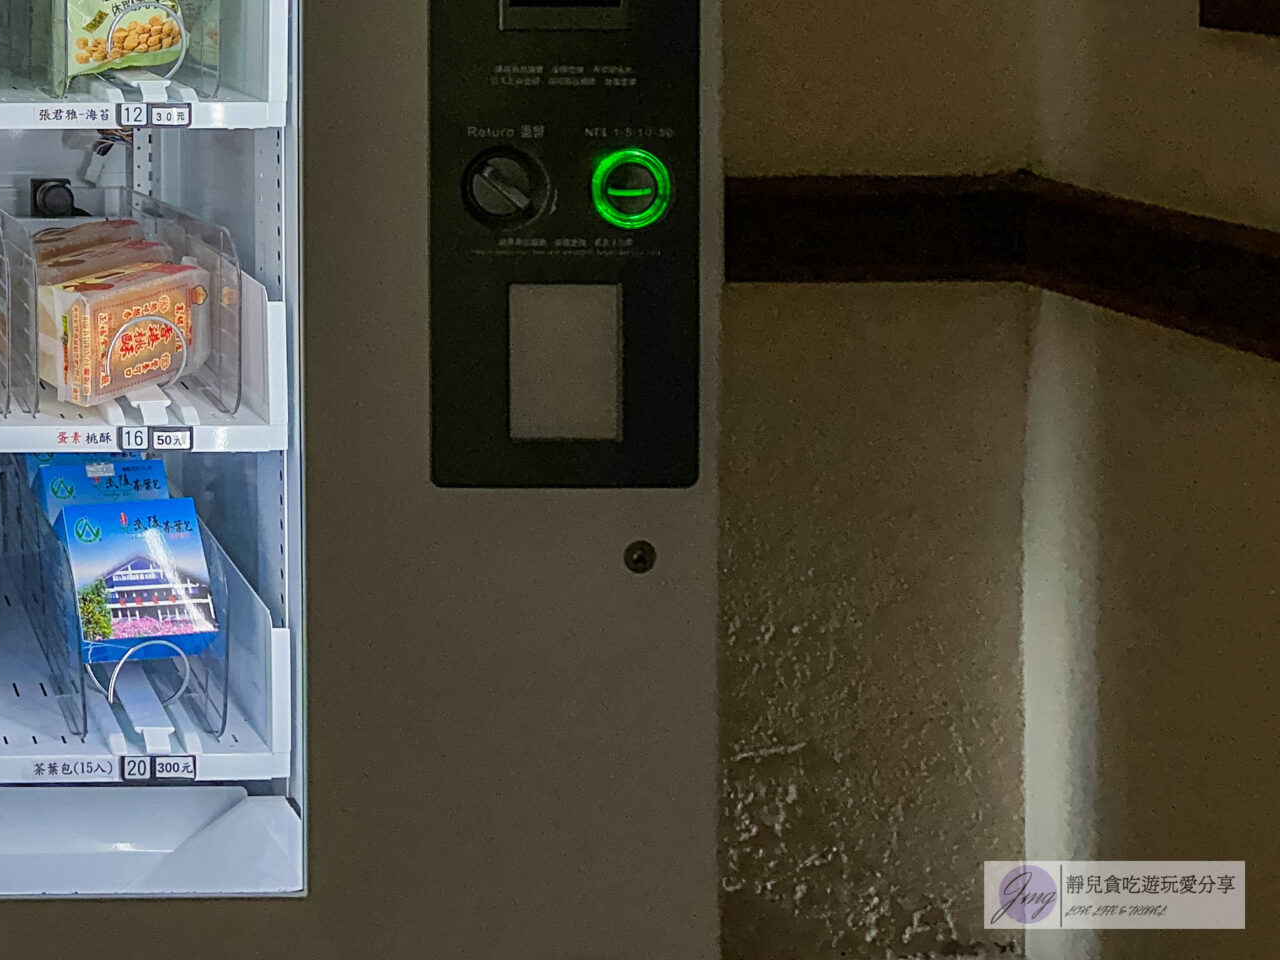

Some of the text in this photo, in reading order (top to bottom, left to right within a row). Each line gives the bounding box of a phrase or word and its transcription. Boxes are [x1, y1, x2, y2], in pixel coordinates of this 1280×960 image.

[38, 108, 110, 121] 張君雅-海苔
[123, 106, 143, 123] 12
[56, 431, 112, 446] 蛋素 桃酥
[124, 430, 143, 447] 16
[156, 435, 187, 447] 50元
[33, 761, 114, 776] 茶葉包(15入)
[127, 759, 147, 776] 20
[157, 762, 194, 774] 300元
